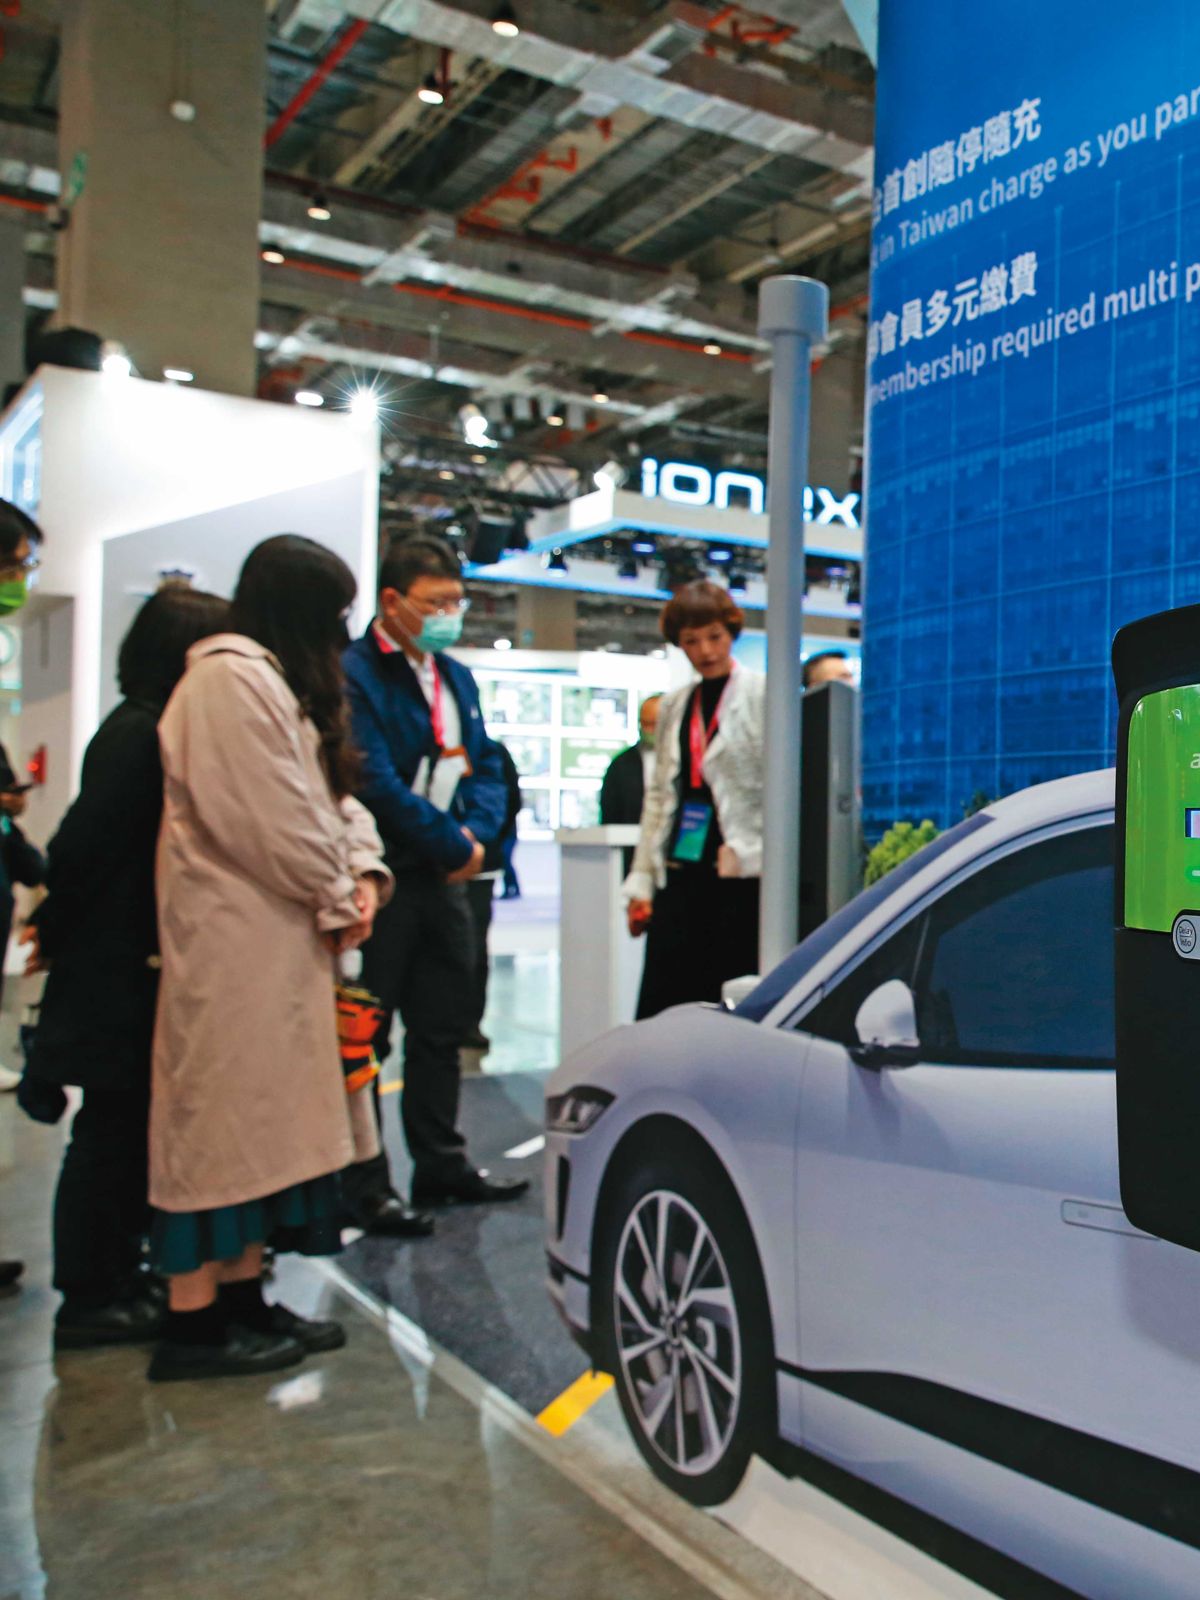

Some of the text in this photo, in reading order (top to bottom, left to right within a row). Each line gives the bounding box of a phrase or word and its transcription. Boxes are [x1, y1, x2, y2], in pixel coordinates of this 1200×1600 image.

[898, 198, 973, 249] Taiwan
[978, 157, 1057, 213] charge
[1064, 141, 1092, 173] as
[1097, 112, 1147, 167] you
[991, 291, 1096, 358] required
[1103, 262, 1178, 321] multi
[641, 457, 860, 529] ionx
[1178, 926, 1194, 936] Delay
